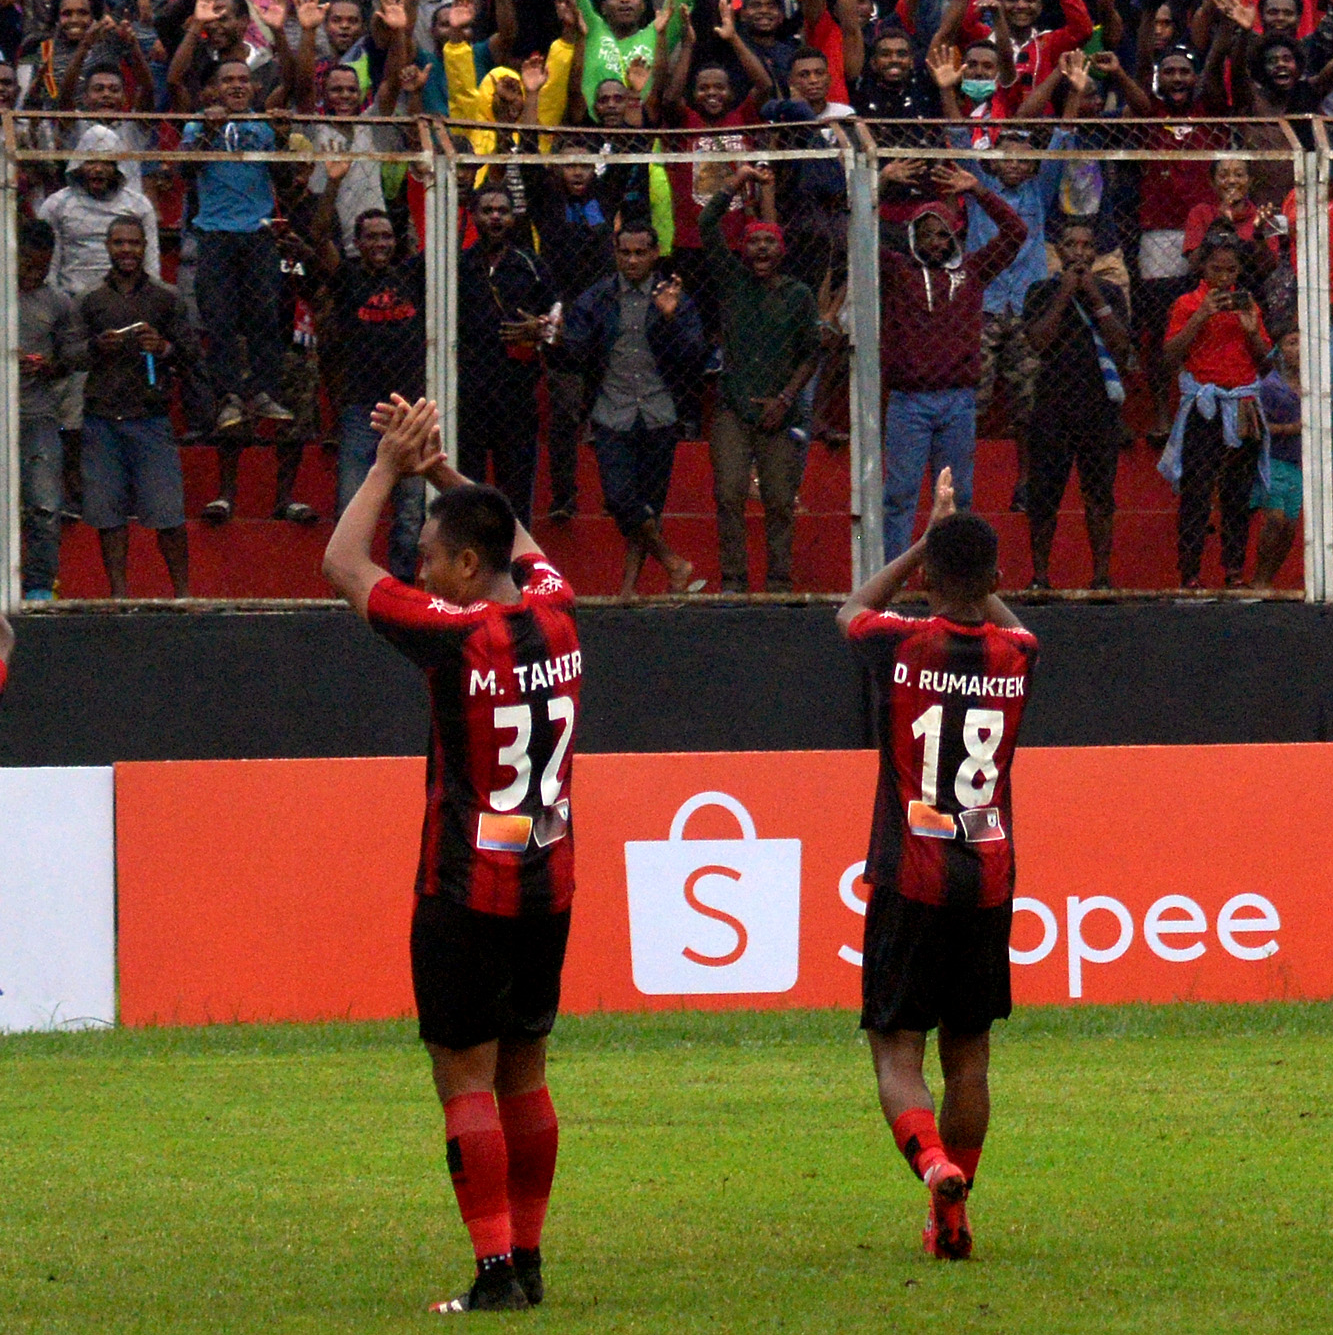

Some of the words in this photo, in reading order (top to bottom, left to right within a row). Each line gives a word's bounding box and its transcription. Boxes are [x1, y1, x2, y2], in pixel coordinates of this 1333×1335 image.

[469, 669, 505, 696] M.
[512, 650, 582, 693] TAHIR
[893, 662, 911, 688] D.
[918, 669, 1025, 698] RUMAKIEK
[489, 695, 575, 812] 32
[911, 704, 1005, 809] 18
